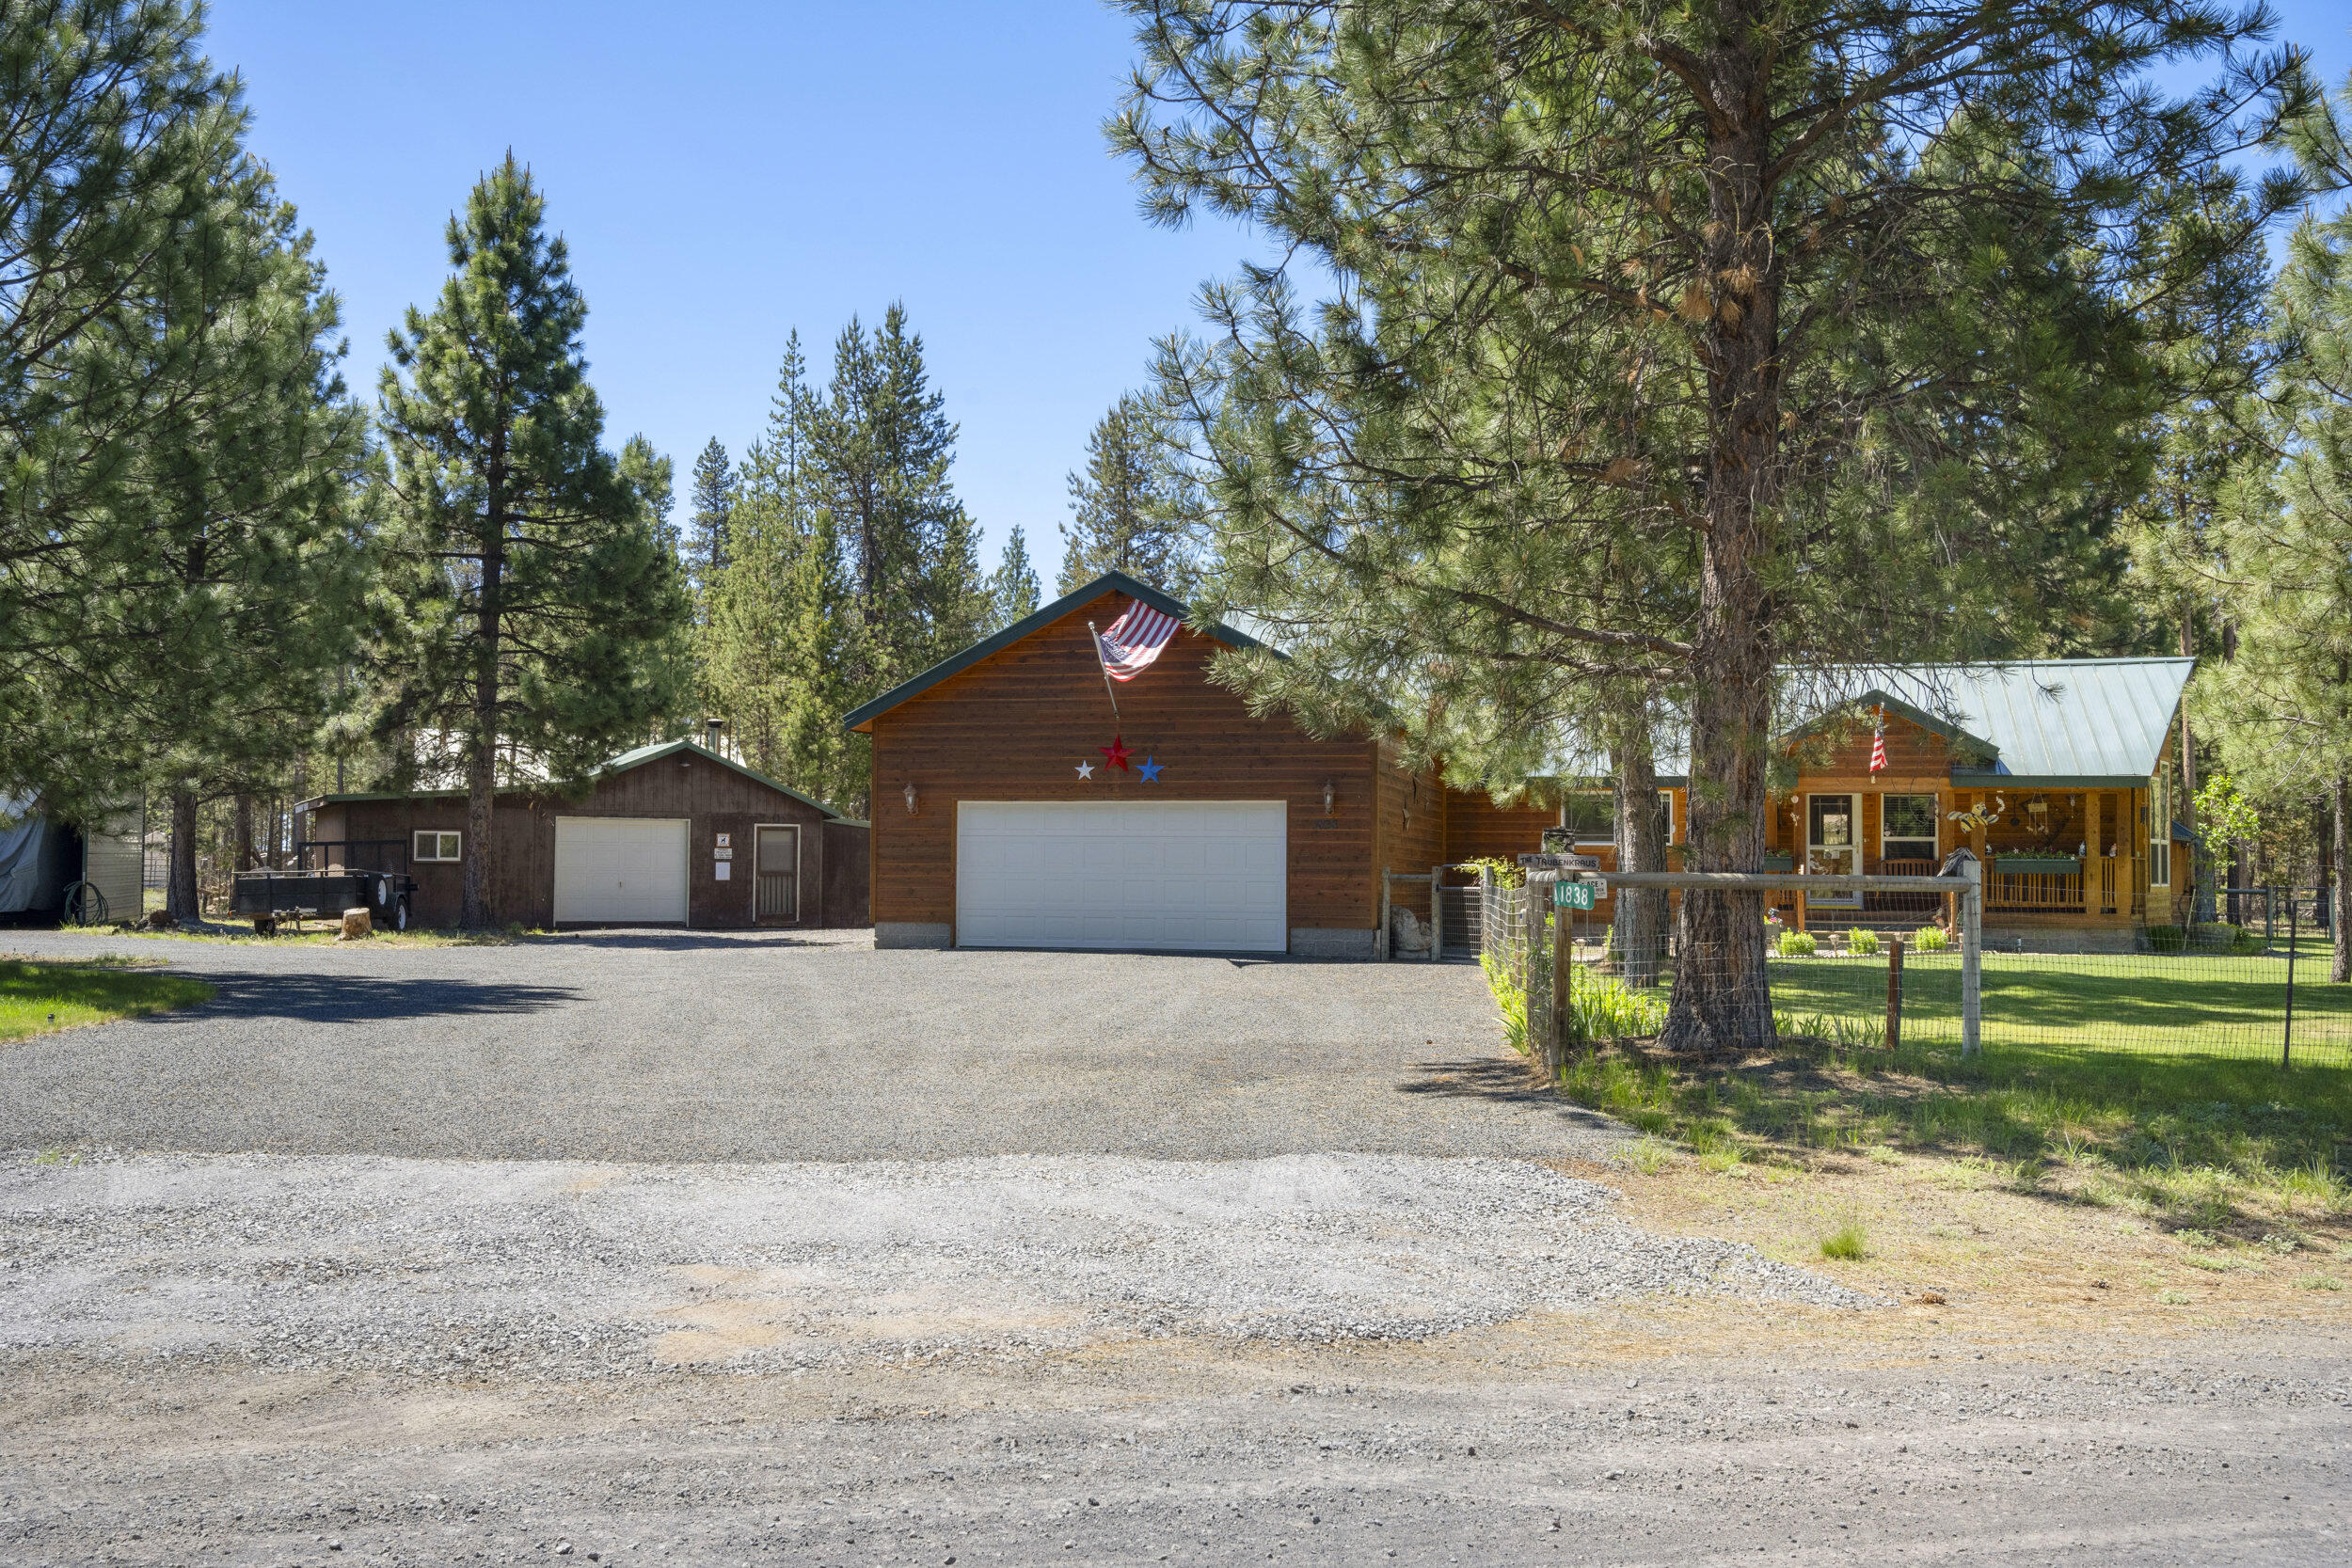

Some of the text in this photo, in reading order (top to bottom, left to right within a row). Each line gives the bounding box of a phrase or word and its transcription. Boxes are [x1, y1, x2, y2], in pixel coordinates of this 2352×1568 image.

[1520, 856, 1597, 867] THE TAUBENKRAUS
[1561, 885, 1588, 906] 1838
